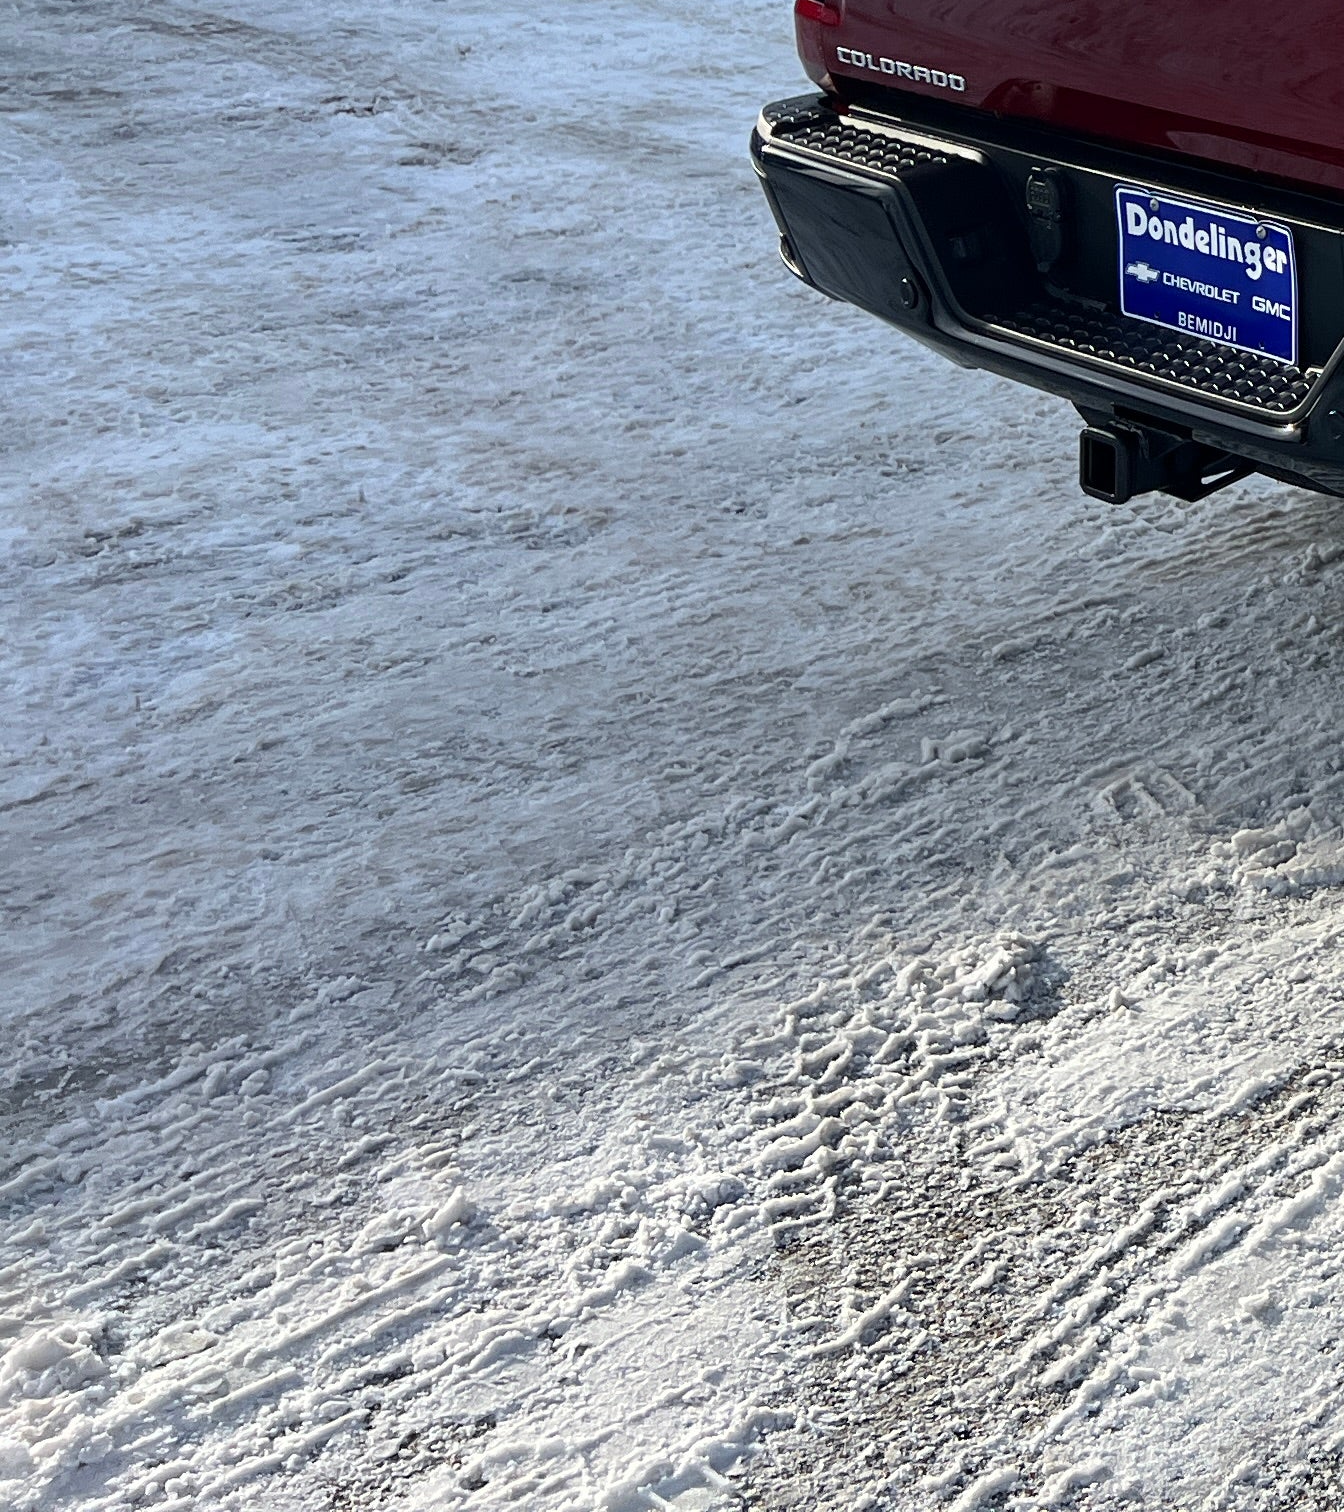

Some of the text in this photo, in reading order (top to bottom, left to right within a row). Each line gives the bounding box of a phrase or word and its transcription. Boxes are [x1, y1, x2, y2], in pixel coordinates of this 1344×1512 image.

[836, 46, 966, 92] COLORADO
[1125, 201, 1288, 281] Dondelinger
[1162, 271, 1291, 321] CHEVROLET GMC
[1178, 311, 1237, 342] BEMIDJI
